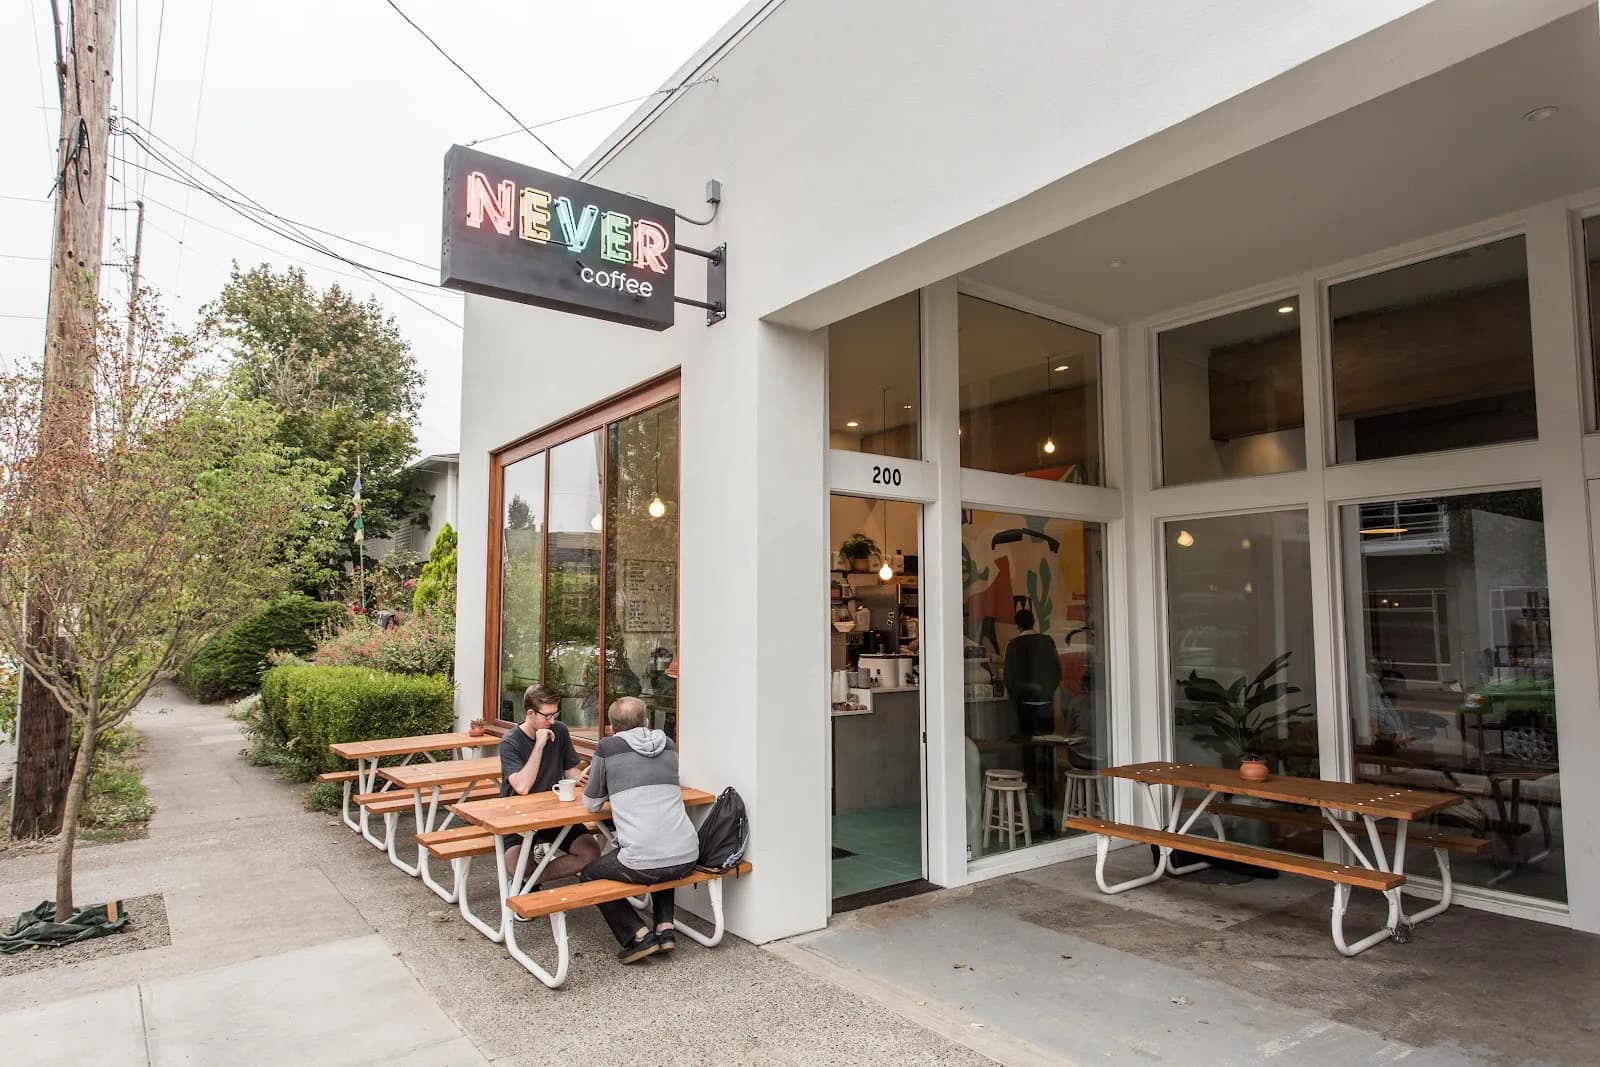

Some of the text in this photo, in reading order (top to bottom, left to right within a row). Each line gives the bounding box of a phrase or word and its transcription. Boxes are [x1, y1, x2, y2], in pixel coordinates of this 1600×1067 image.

[466, 171, 670, 274] NEVER
[580, 265, 653, 298] coffee
[872, 465, 902, 487] 200
